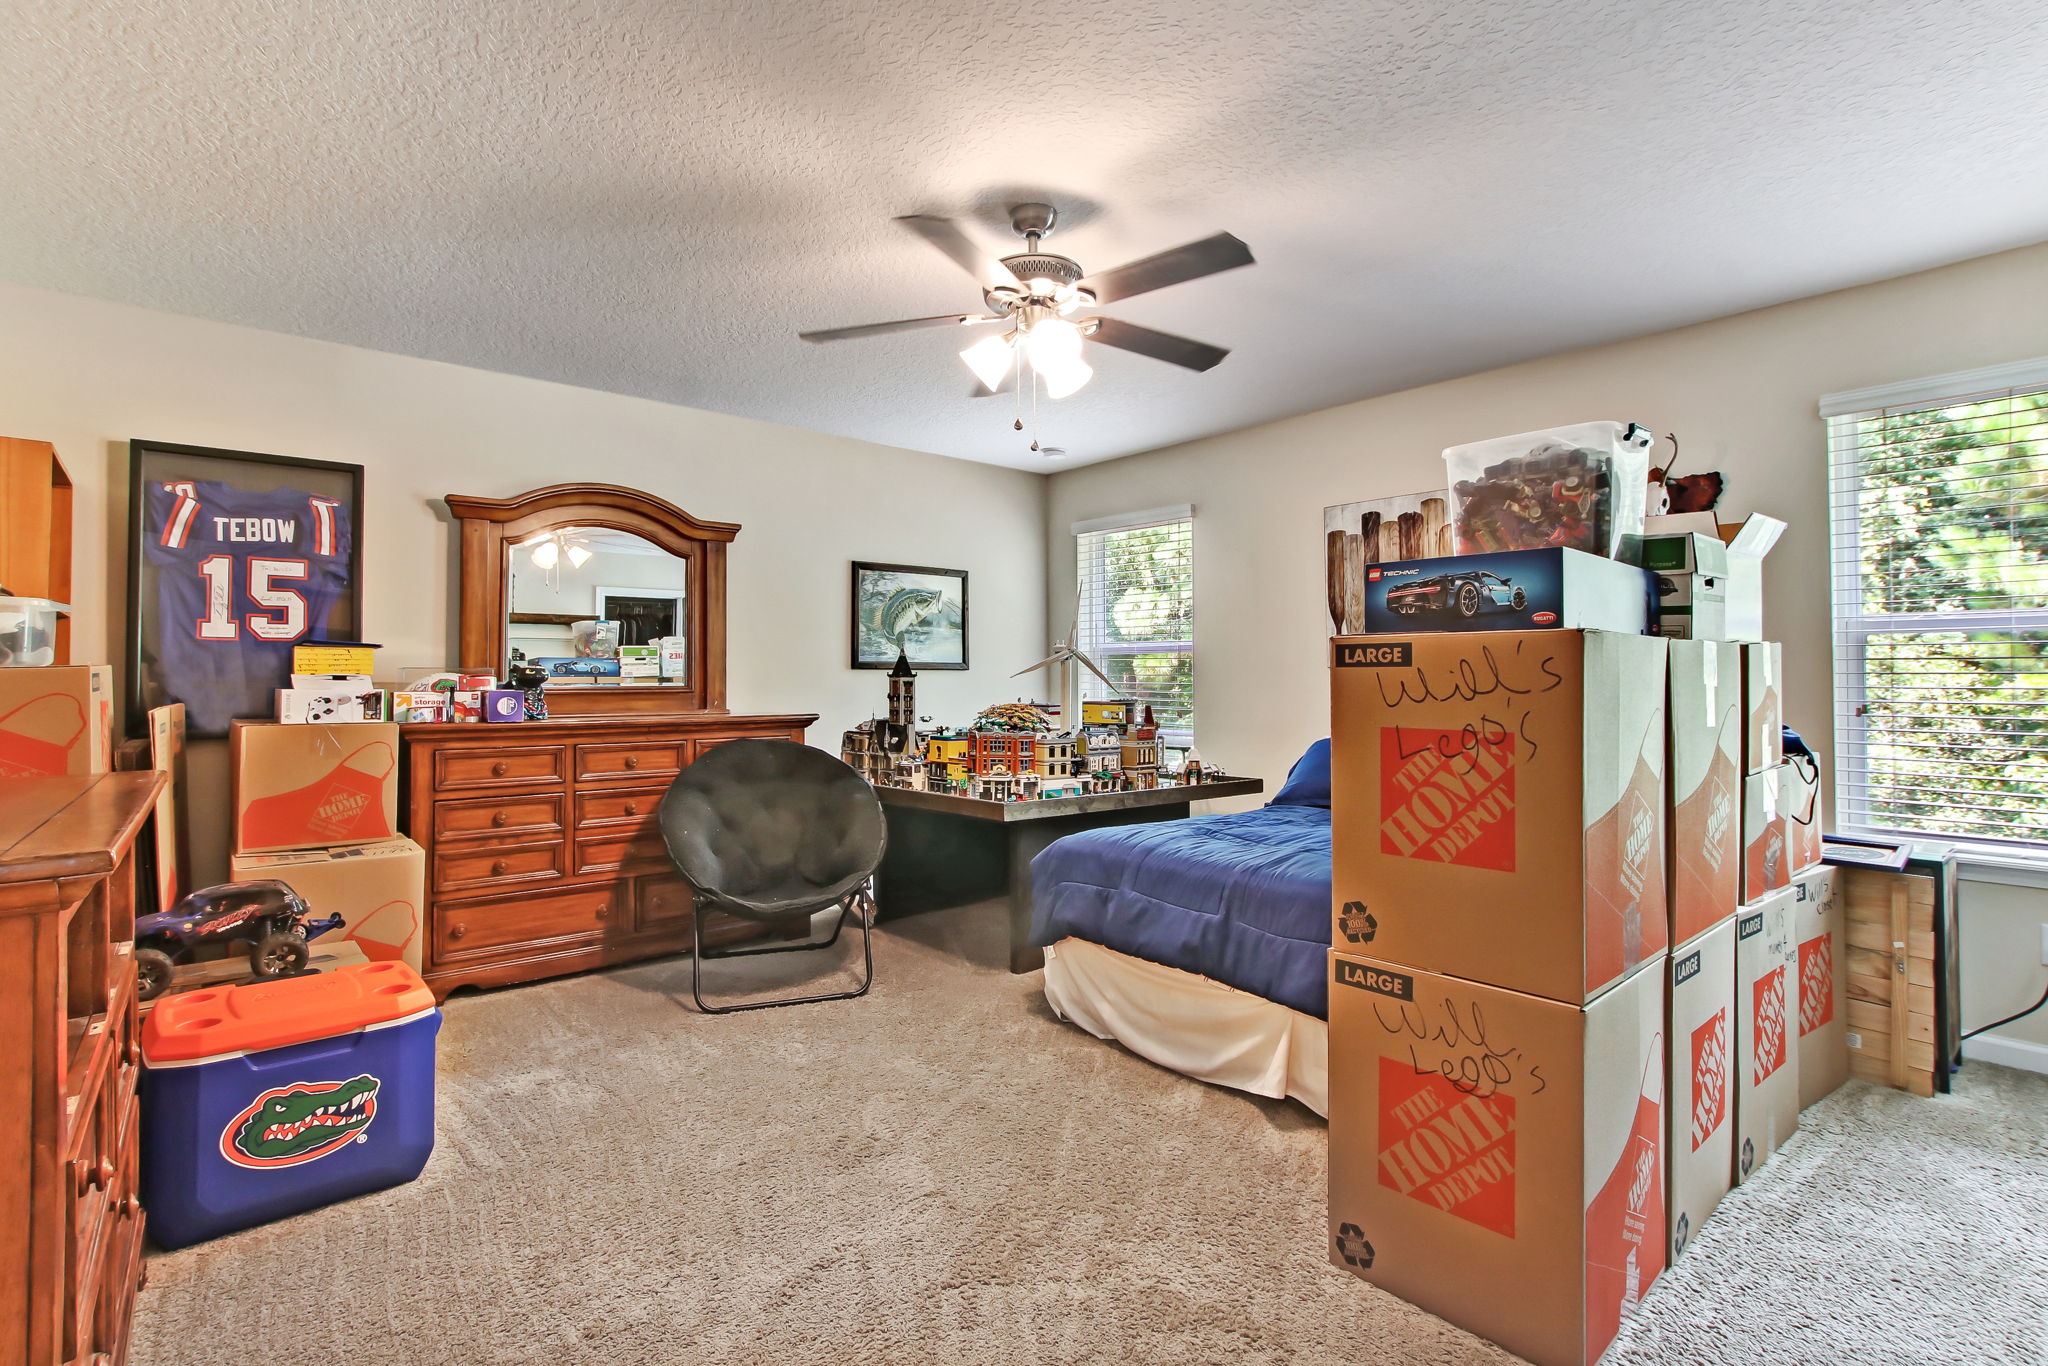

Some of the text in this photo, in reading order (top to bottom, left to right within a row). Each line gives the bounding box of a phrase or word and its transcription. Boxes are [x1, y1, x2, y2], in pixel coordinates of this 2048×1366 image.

[213, 517, 295, 543] TEBOW
[1383, 569, 1420, 577] TECHNIC
[196, 554, 309, 641] 15
[1344, 647, 1402, 664] LARGE
[1376, 639, 1562, 707] Will's
[1392, 744, 1446, 793] THE
[318, 793, 369, 818] HOME
[1381, 732, 1515, 858] HOME
[1430, 784, 1515, 864] DEPOT
[1741, 917, 1761, 936] LARGE
[1344, 966, 1403, 994] LARGE
[1677, 956, 1698, 980] LARGE
[1373, 998, 1516, 1057] Will
[1391, 1085, 1446, 1130] THE
[1378, 1092, 1516, 1195] HOME
[1428, 1146, 1515, 1212] DEPOT
